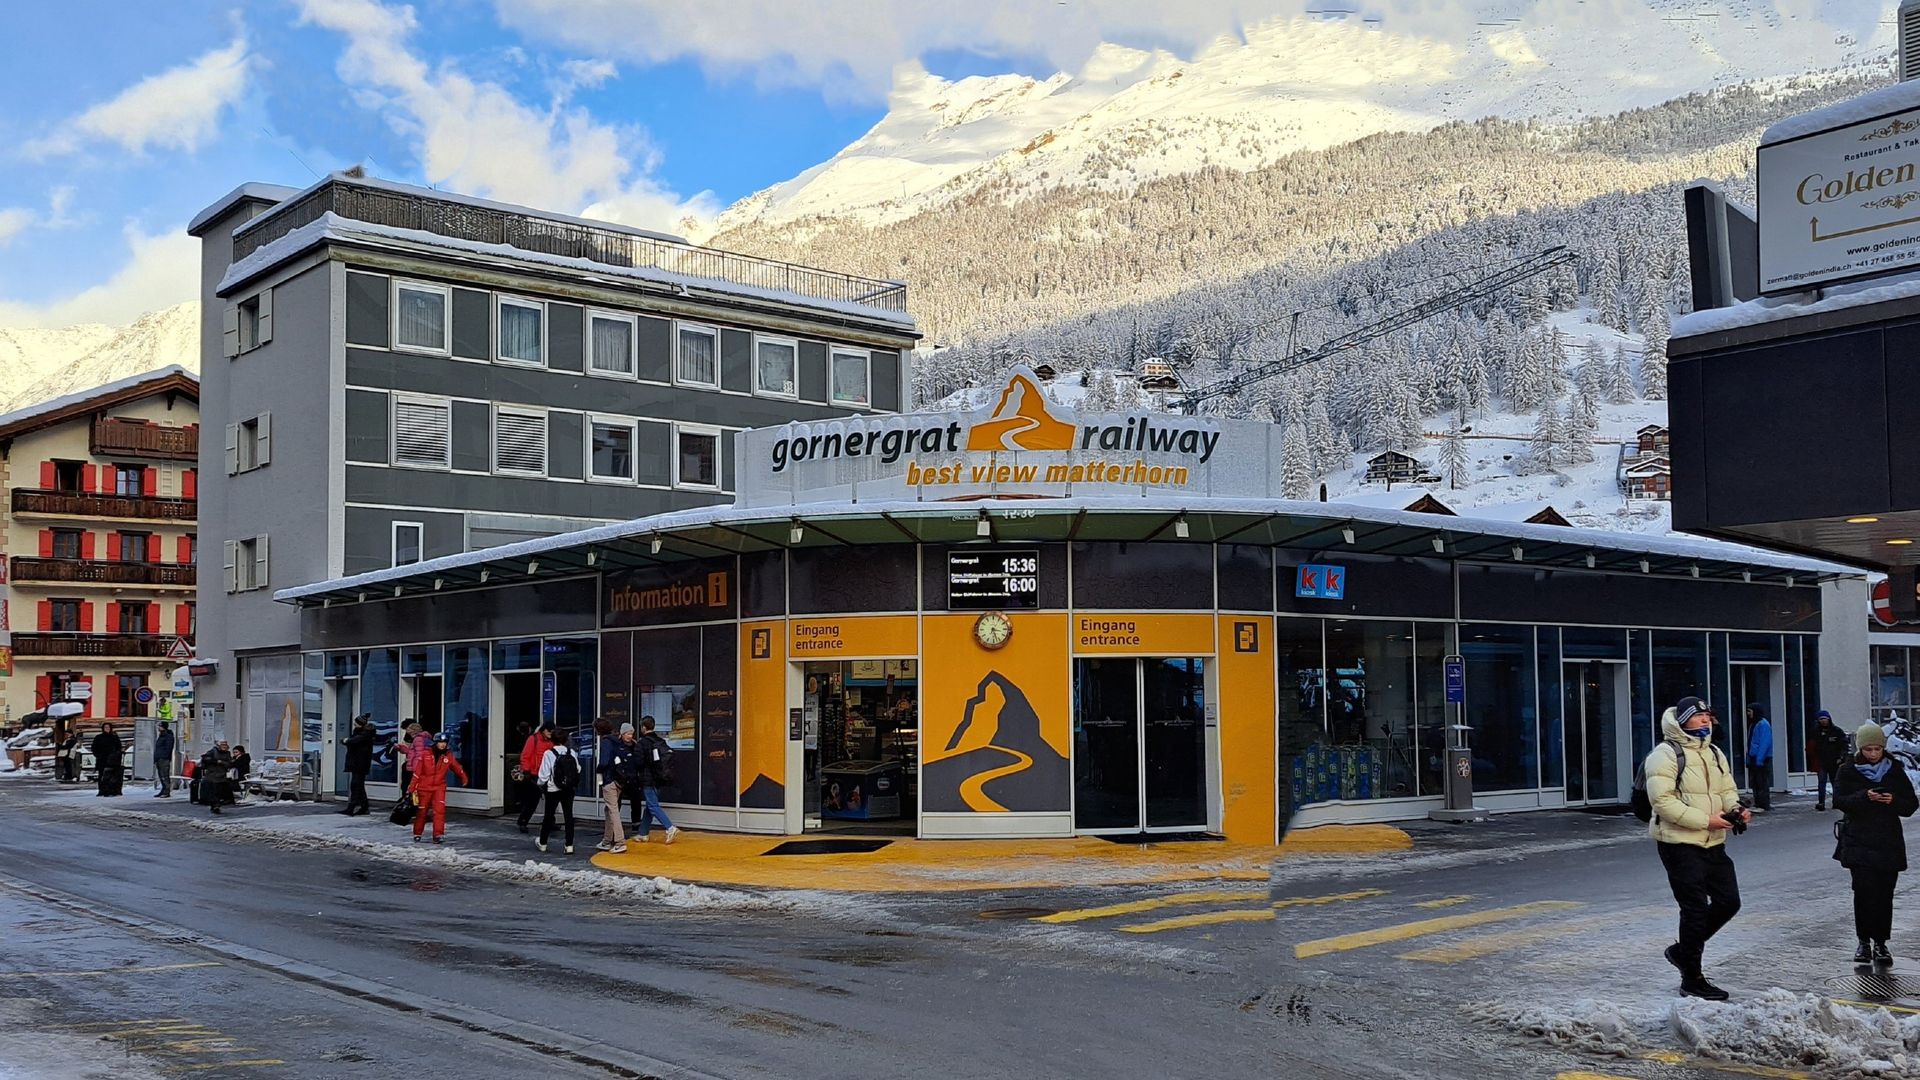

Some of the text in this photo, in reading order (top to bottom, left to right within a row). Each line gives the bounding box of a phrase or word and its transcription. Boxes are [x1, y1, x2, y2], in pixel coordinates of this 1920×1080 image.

[1844, 145, 1892, 161] Restaurant
[1895, 142, 1901, 150] &
[1797, 162, 1914, 205] Golden
[1870, 257, 1879, 265] 27
[772, 417, 1220, 472] gornergrat railway
[907, 458, 1189, 486] best view matterhorn
[1002, 558, 1036, 573] 15:36
[1002, 578, 1036, 592] 16:00
[1302, 567, 1317, 589] k
[1326, 568, 1340, 590] k
[610, 581, 704, 611] Information
[796, 624, 839, 638] Eingang
[1081, 619, 1135, 633] Eingang
[795, 639, 843, 649] entrance
[1081, 635, 1140, 645] entrance
